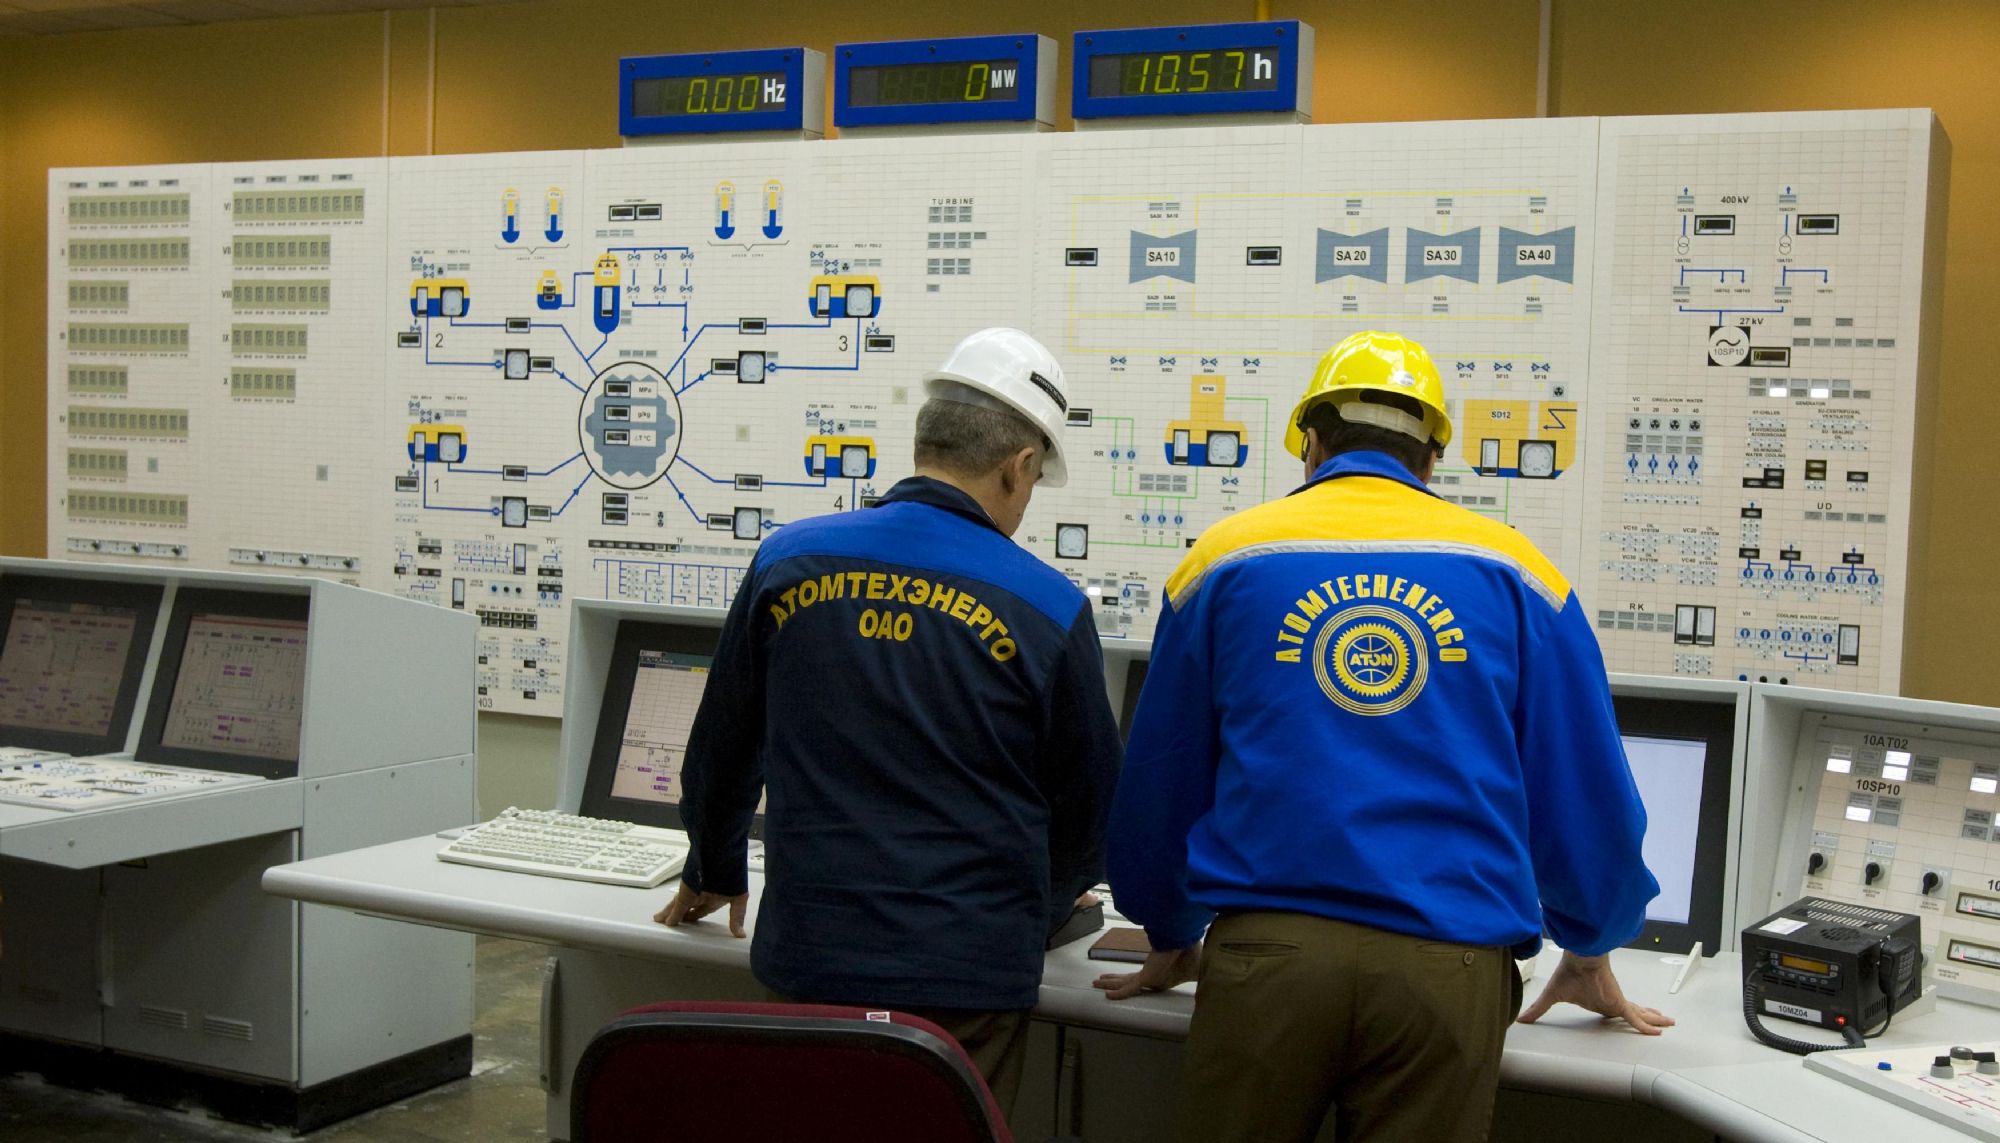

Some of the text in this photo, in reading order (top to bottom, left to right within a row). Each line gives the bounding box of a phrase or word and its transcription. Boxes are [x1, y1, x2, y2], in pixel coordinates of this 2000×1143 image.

[1139, 51, 1272, 93] 10.57 h
[964, 63, 1016, 101] 0 MW
[686, 75, 786, 113] 0.00 Hz
[1737, 195, 1750, 204] kV
[1739, 317, 1764, 325] 27 kV
[434, 333, 444, 348] 2
[838, 335, 848, 351] 3
[1713, 347, 1745, 356] 10SP10
[434, 478, 440, 493] 1
[833, 495, 844, 512] 4
[770, 572, 1017, 662] АТОМТЕХЭНЕРГО
[858, 608, 913, 641] ОАО
[1275, 574, 1468, 663] ATOMTECHENERGO
[1863, 734, 1909, 750] 10AT02
[1855, 778, 1901, 796] 10SP10
[1778, 1005, 1808, 1018] 10MZ04
